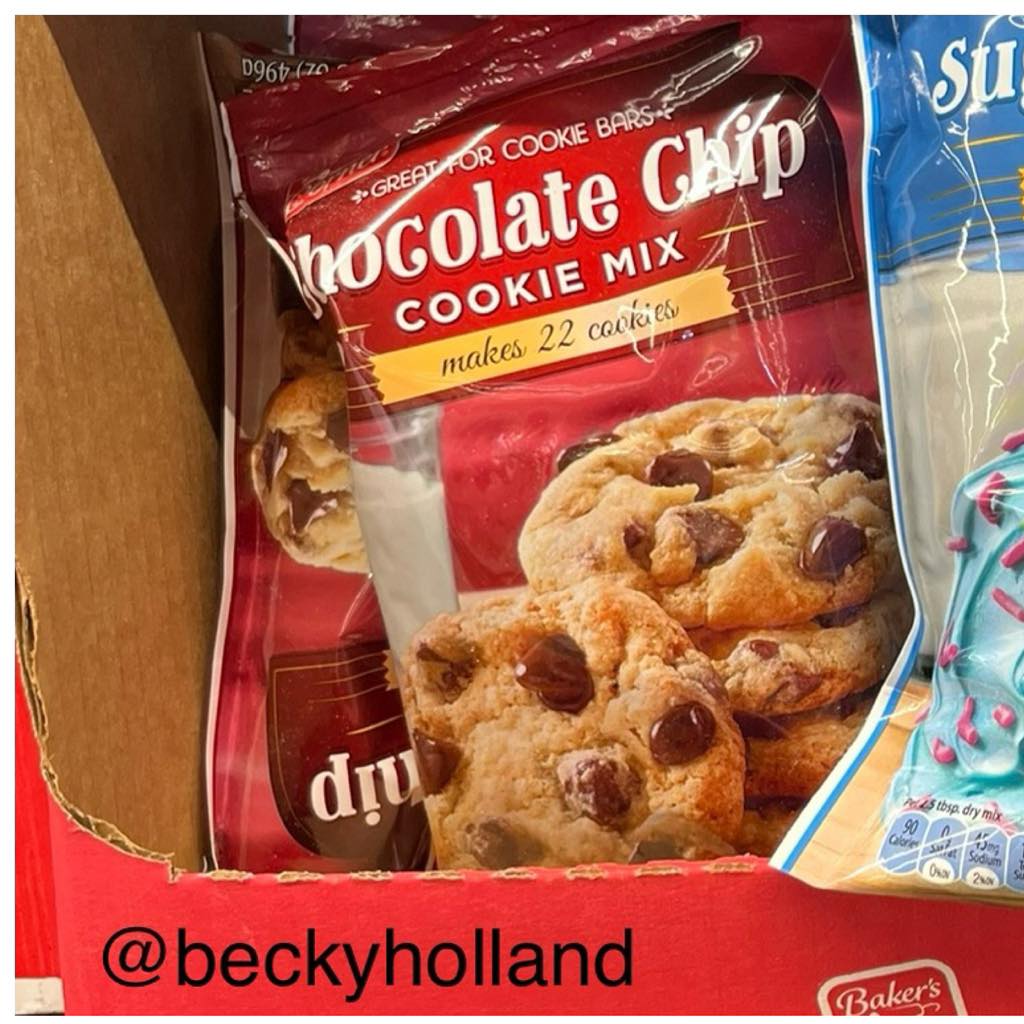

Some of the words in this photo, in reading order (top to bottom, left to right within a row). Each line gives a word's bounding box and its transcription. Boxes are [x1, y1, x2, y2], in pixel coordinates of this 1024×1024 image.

[370, 159, 438, 199] GREAT
[448, 145, 496, 175] FOR
[502, 122, 590, 160] COOKIE
[595, 106, 655, 139] BARS
[292, 170, 620, 297] hocolate
[641, 113, 807, 213] Chip
[394, 259, 586, 333] COOKIE
[600, 230, 685, 284] MIX
[440, 335, 530, 378] makes
[538, 318, 577, 353] 22
[587, 299, 681, 342] cookies
[902, 818, 919, 836] 90
[962, 804, 981, 820] dry
[982, 808, 1003, 821] mix
[836, 977, 942, 1016] Baker's
